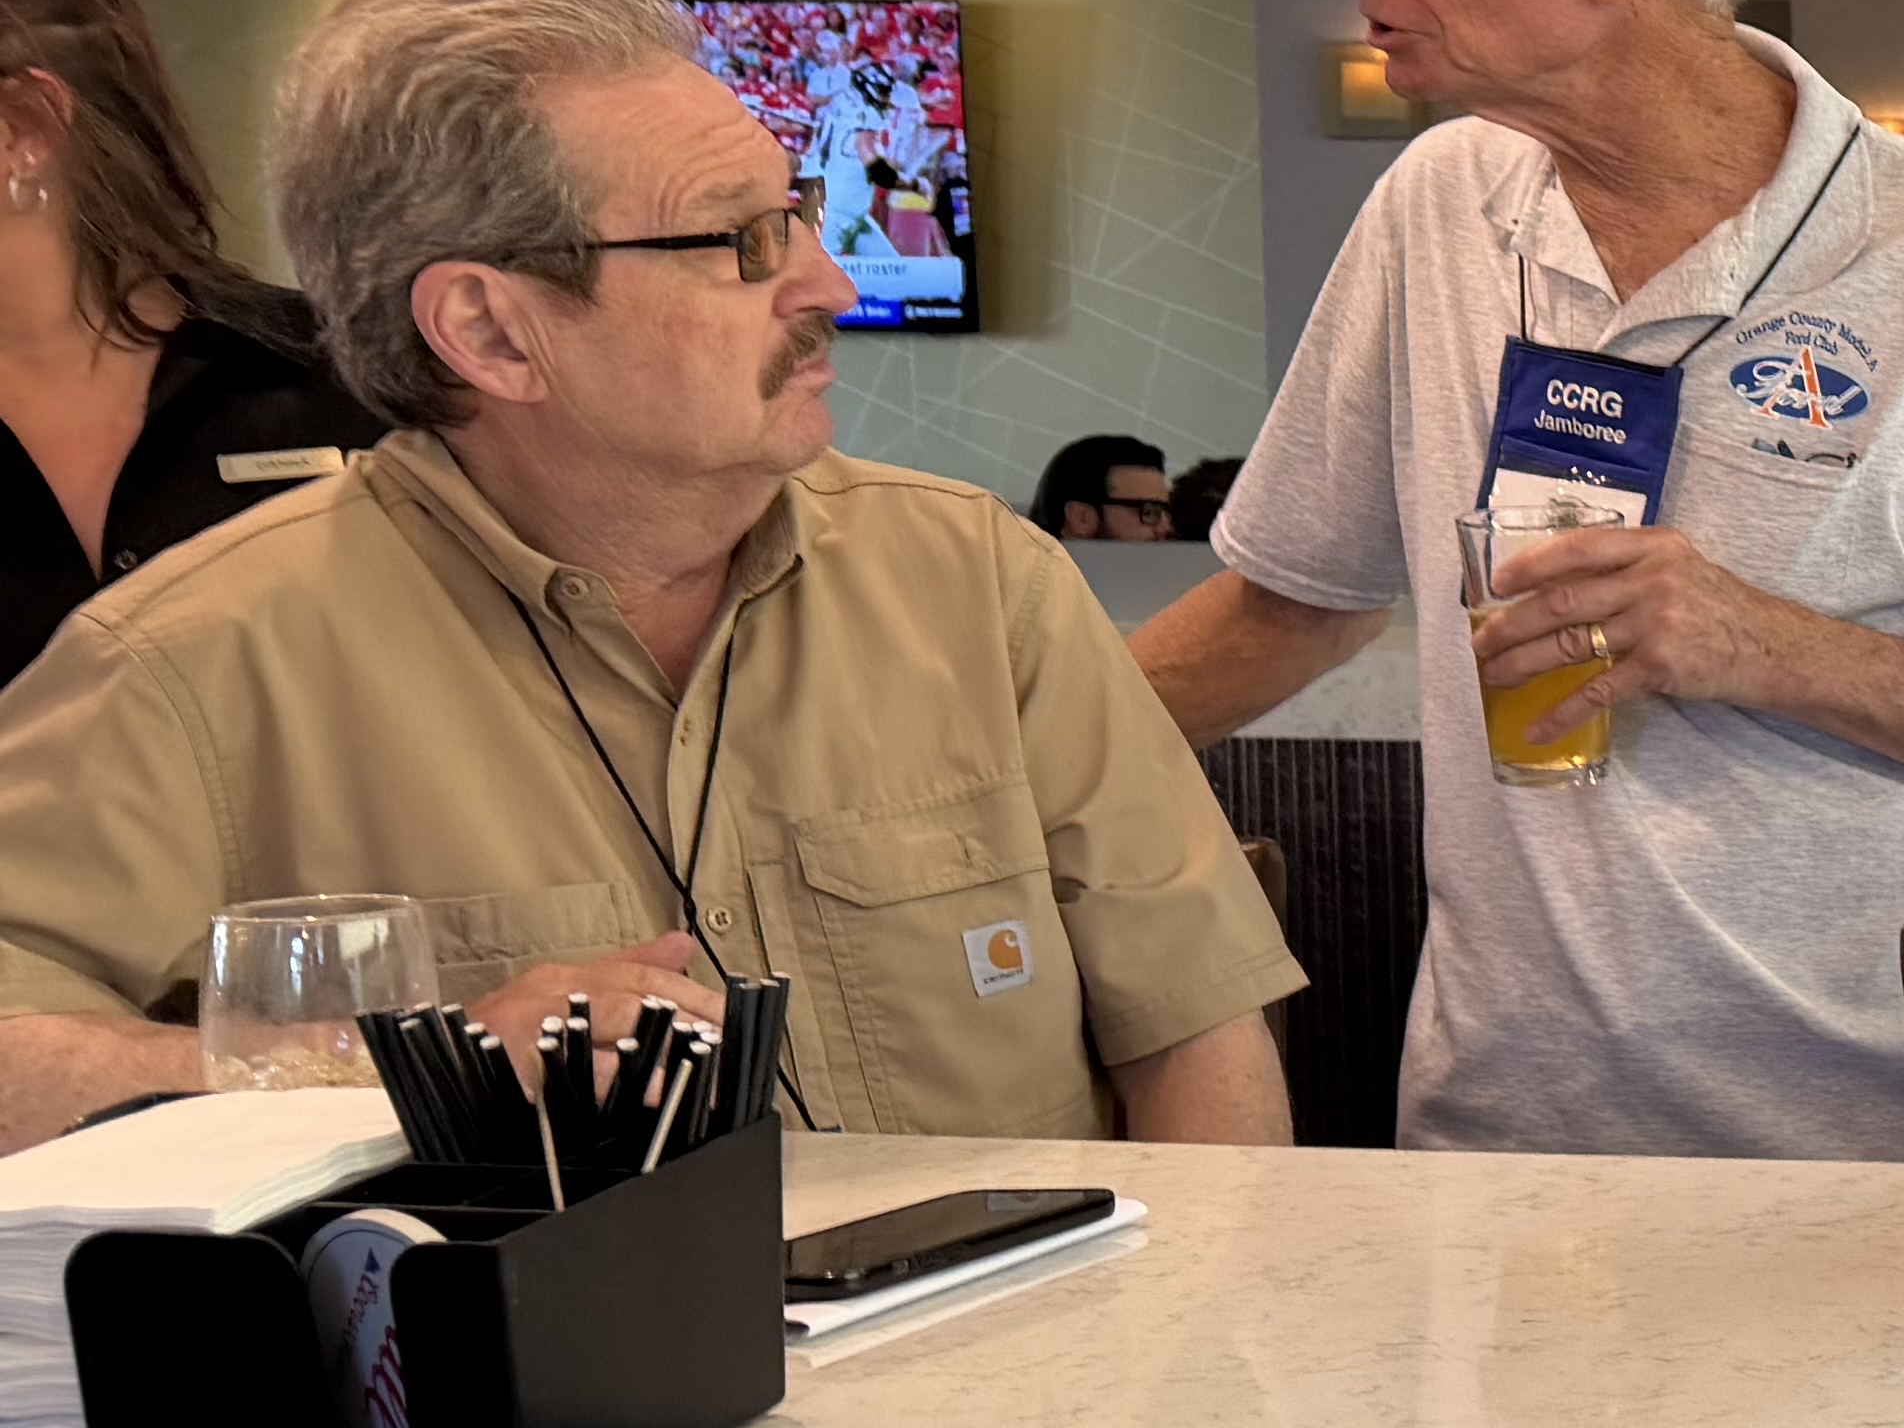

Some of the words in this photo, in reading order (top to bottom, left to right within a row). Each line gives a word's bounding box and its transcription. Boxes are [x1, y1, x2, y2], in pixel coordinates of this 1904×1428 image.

[1736, 316, 1786, 344] Orange
[1789, 311, 1837, 335] County
[1839, 323, 1872, 356] Model
[1785, 331, 1811, 345] Ford
[1814, 334, 1838, 356] Club
[1547, 379, 1624, 419] CCRG
[1533, 409, 1627, 445] Jamboree
